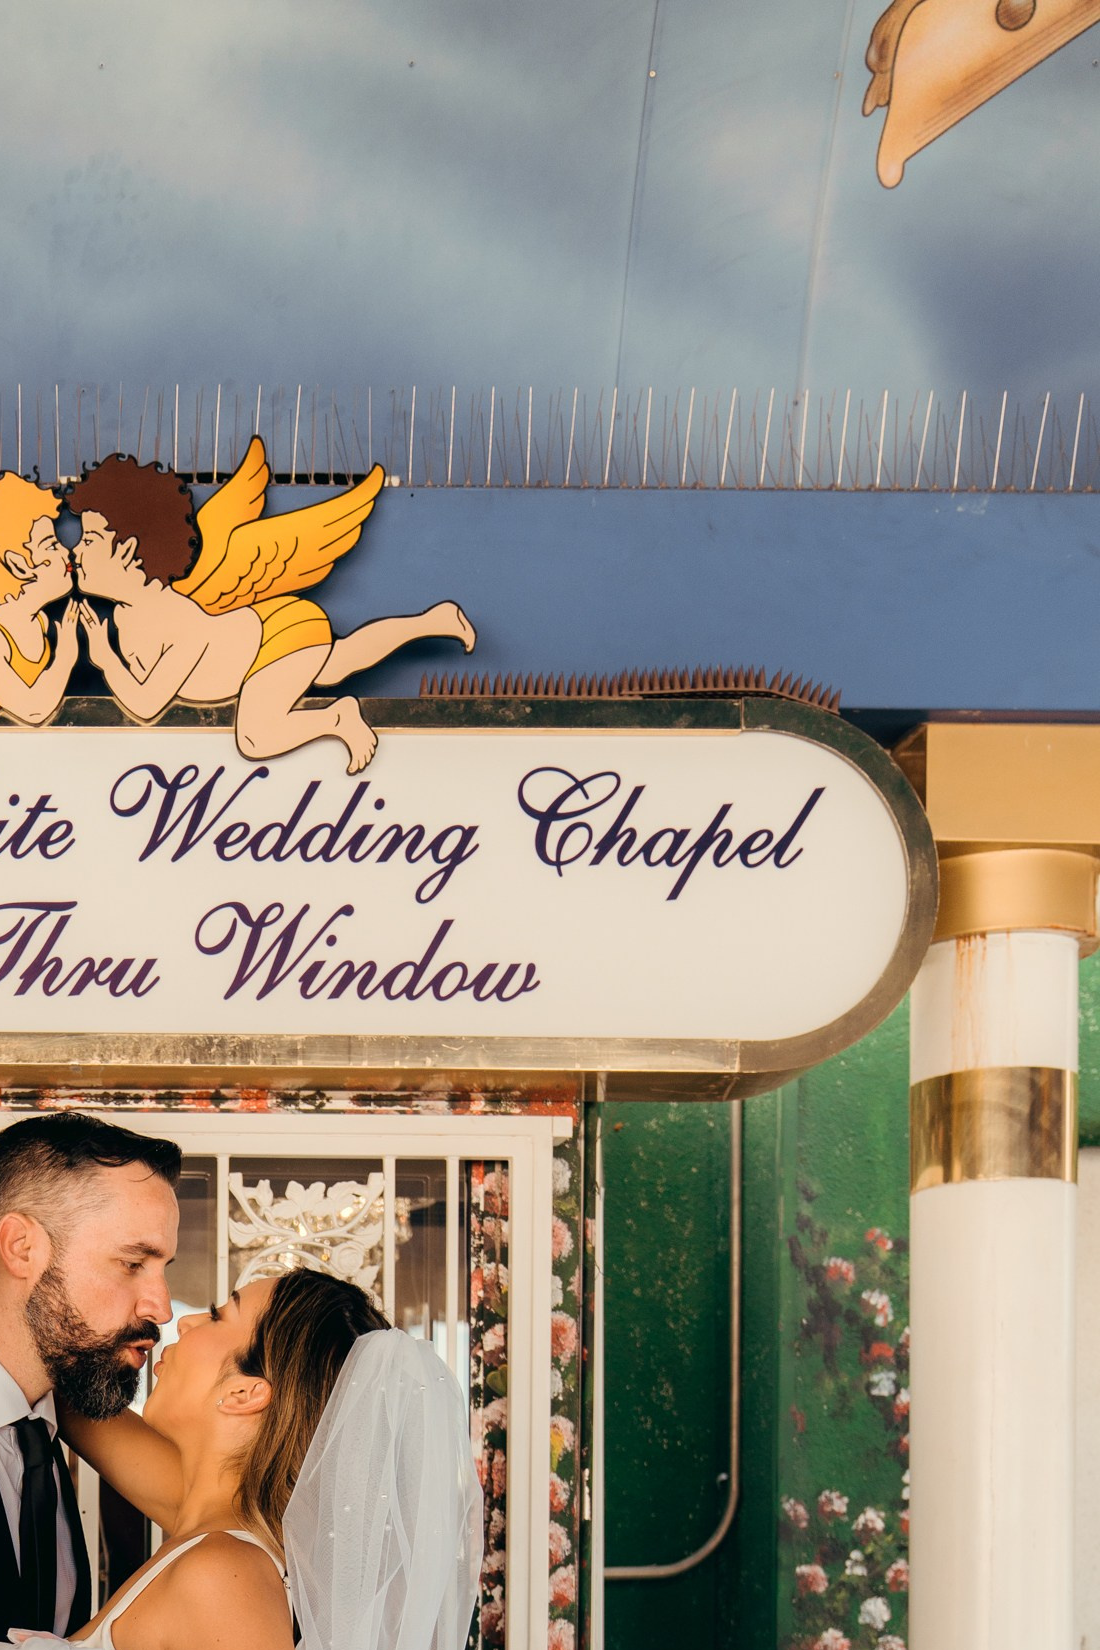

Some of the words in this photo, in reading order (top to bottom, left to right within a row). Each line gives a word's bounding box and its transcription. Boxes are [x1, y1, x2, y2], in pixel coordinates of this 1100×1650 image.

[109, 762, 480, 906] Wedding
[517, 766, 826, 901] Chapel
[194, 900, 541, 1003] Window
